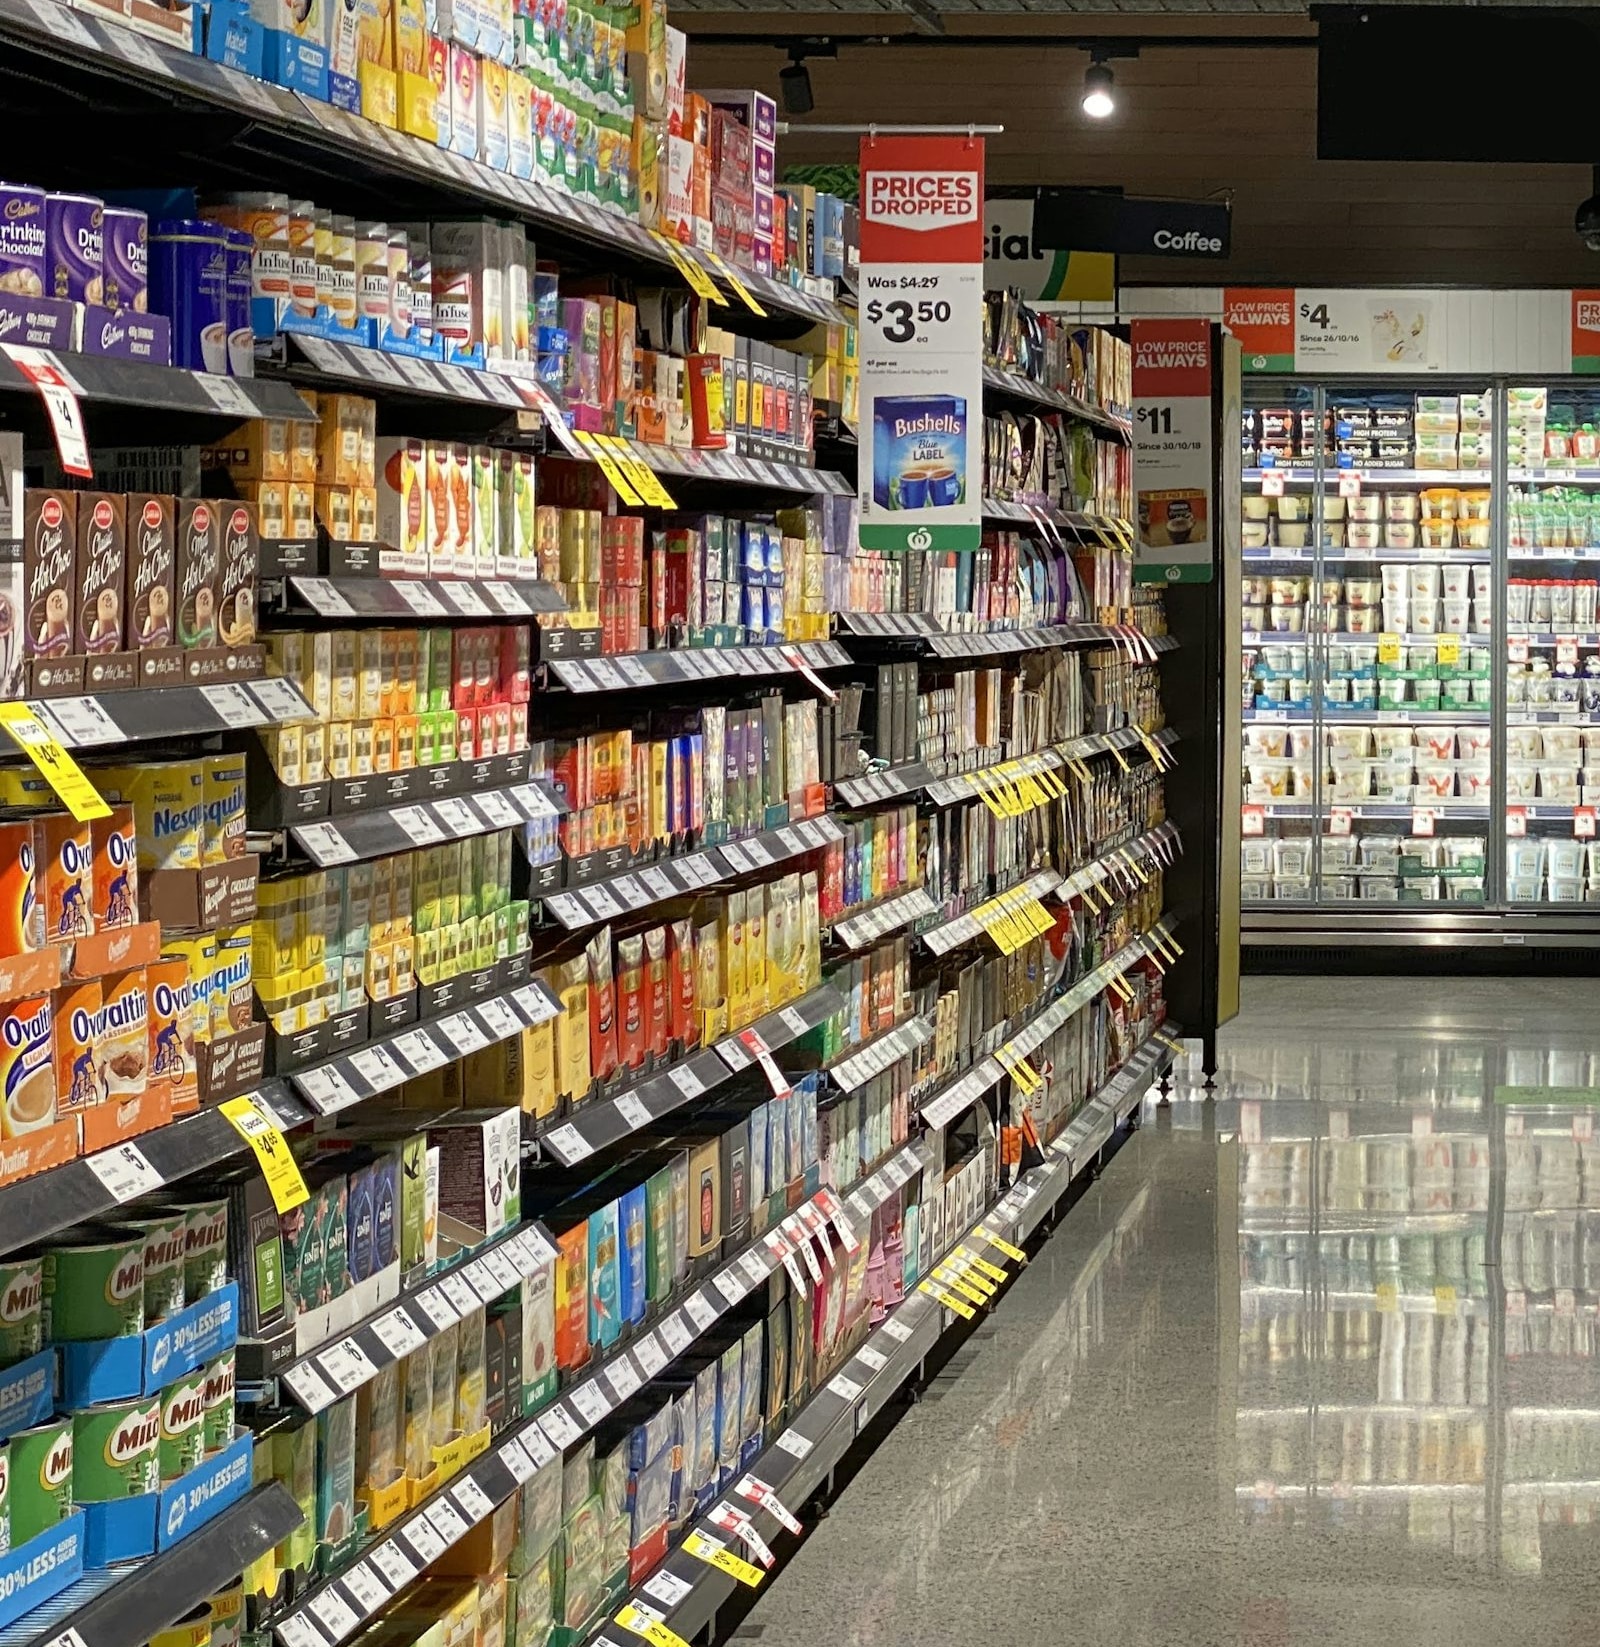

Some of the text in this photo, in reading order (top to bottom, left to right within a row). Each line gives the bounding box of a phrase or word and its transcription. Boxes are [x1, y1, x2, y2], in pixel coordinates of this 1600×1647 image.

[872, 177, 972, 198] PRICES
[871, 200, 972, 215] DROPPED
[1154, 229, 1222, 252] Coffee
[867, 276, 939, 289] Was $4.29
[1229, 302, 1289, 312] LOW PRICE
[1229, 312, 1290, 325] ALWAYS
[1300, 303, 1330, 330] $4
[1136, 341, 1206, 352] LOW PRICE
[1300, 334, 1360, 343] Since 26/10/16
[1135, 354, 1207, 368] ALWAYS
[895, 413, 961, 438] Bushells
[1137, 406, 1171, 434] $11
[913, 449, 944, 461] LABEL
[919, 439, 939, 449] Blue
[30, 560, 49, 602] Hot
[83, 560, 100, 601] Hot
[134, 559, 151, 599] Hot
[182, 561, 198, 600] Hot
[222, 562, 238, 599] Hot
[230, 876, 256, 894] CHOCOLATE
[173, 1308, 214, 1353] 30% LESS
[189, 1464, 232, 1512] 30% LESS
[27, 1546, 57, 1585] LESS
